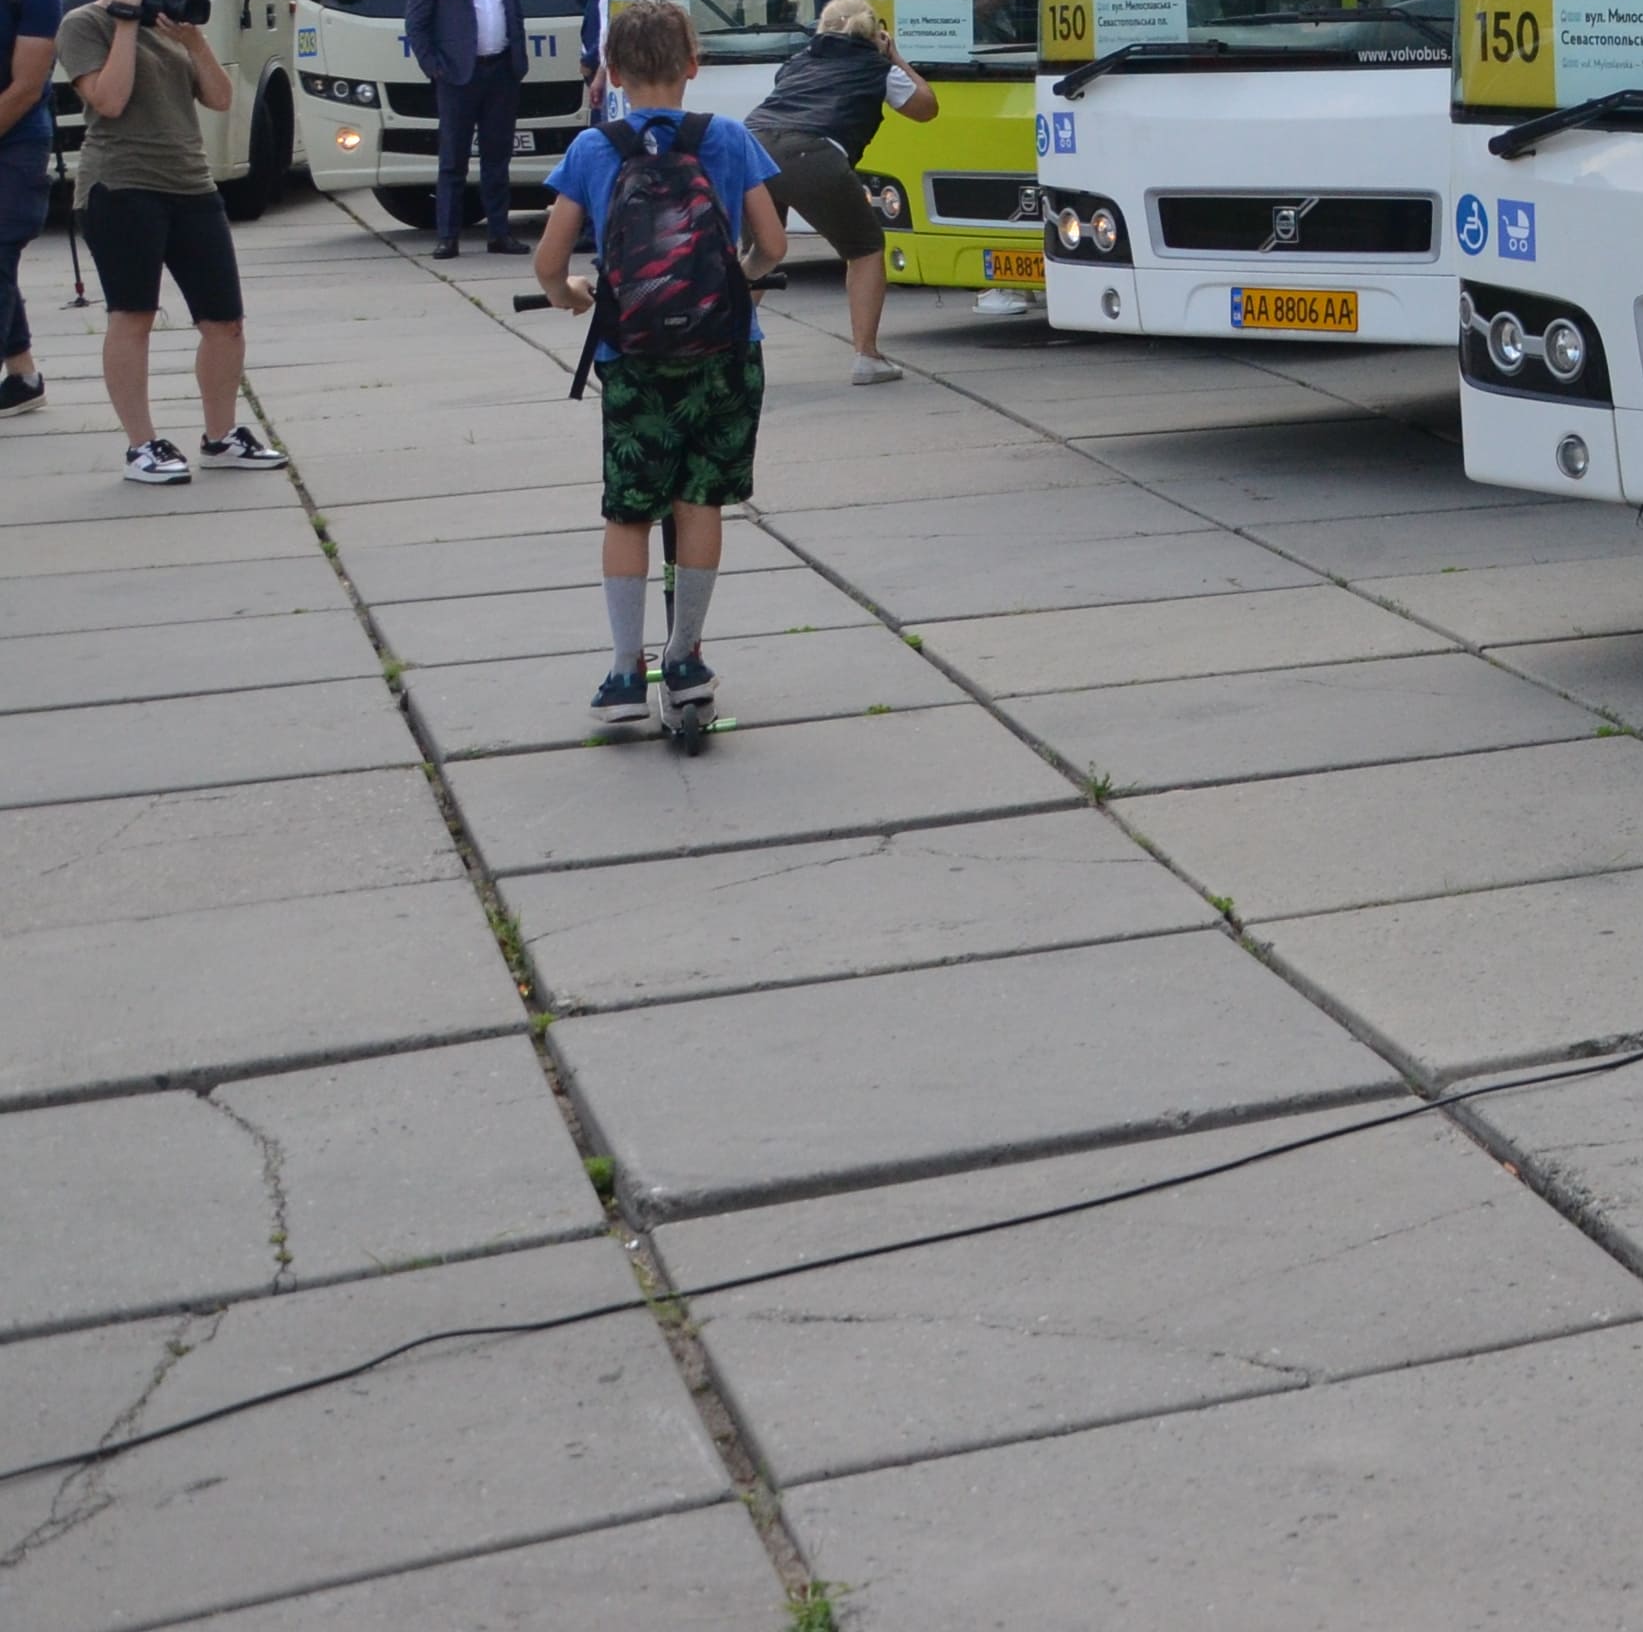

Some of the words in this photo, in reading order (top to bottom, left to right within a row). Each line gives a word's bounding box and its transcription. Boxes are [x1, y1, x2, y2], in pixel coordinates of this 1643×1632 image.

[1049, 4, 1086, 40] 150
[1585, 11, 1606, 28] вул.
[1475, 11, 1540, 63] 150
[993, 255, 1014, 276] AA
[1243, 294, 1269, 321] AA
[1274, 296, 1319, 323] 8806
[1323, 297, 1352, 325] AA
